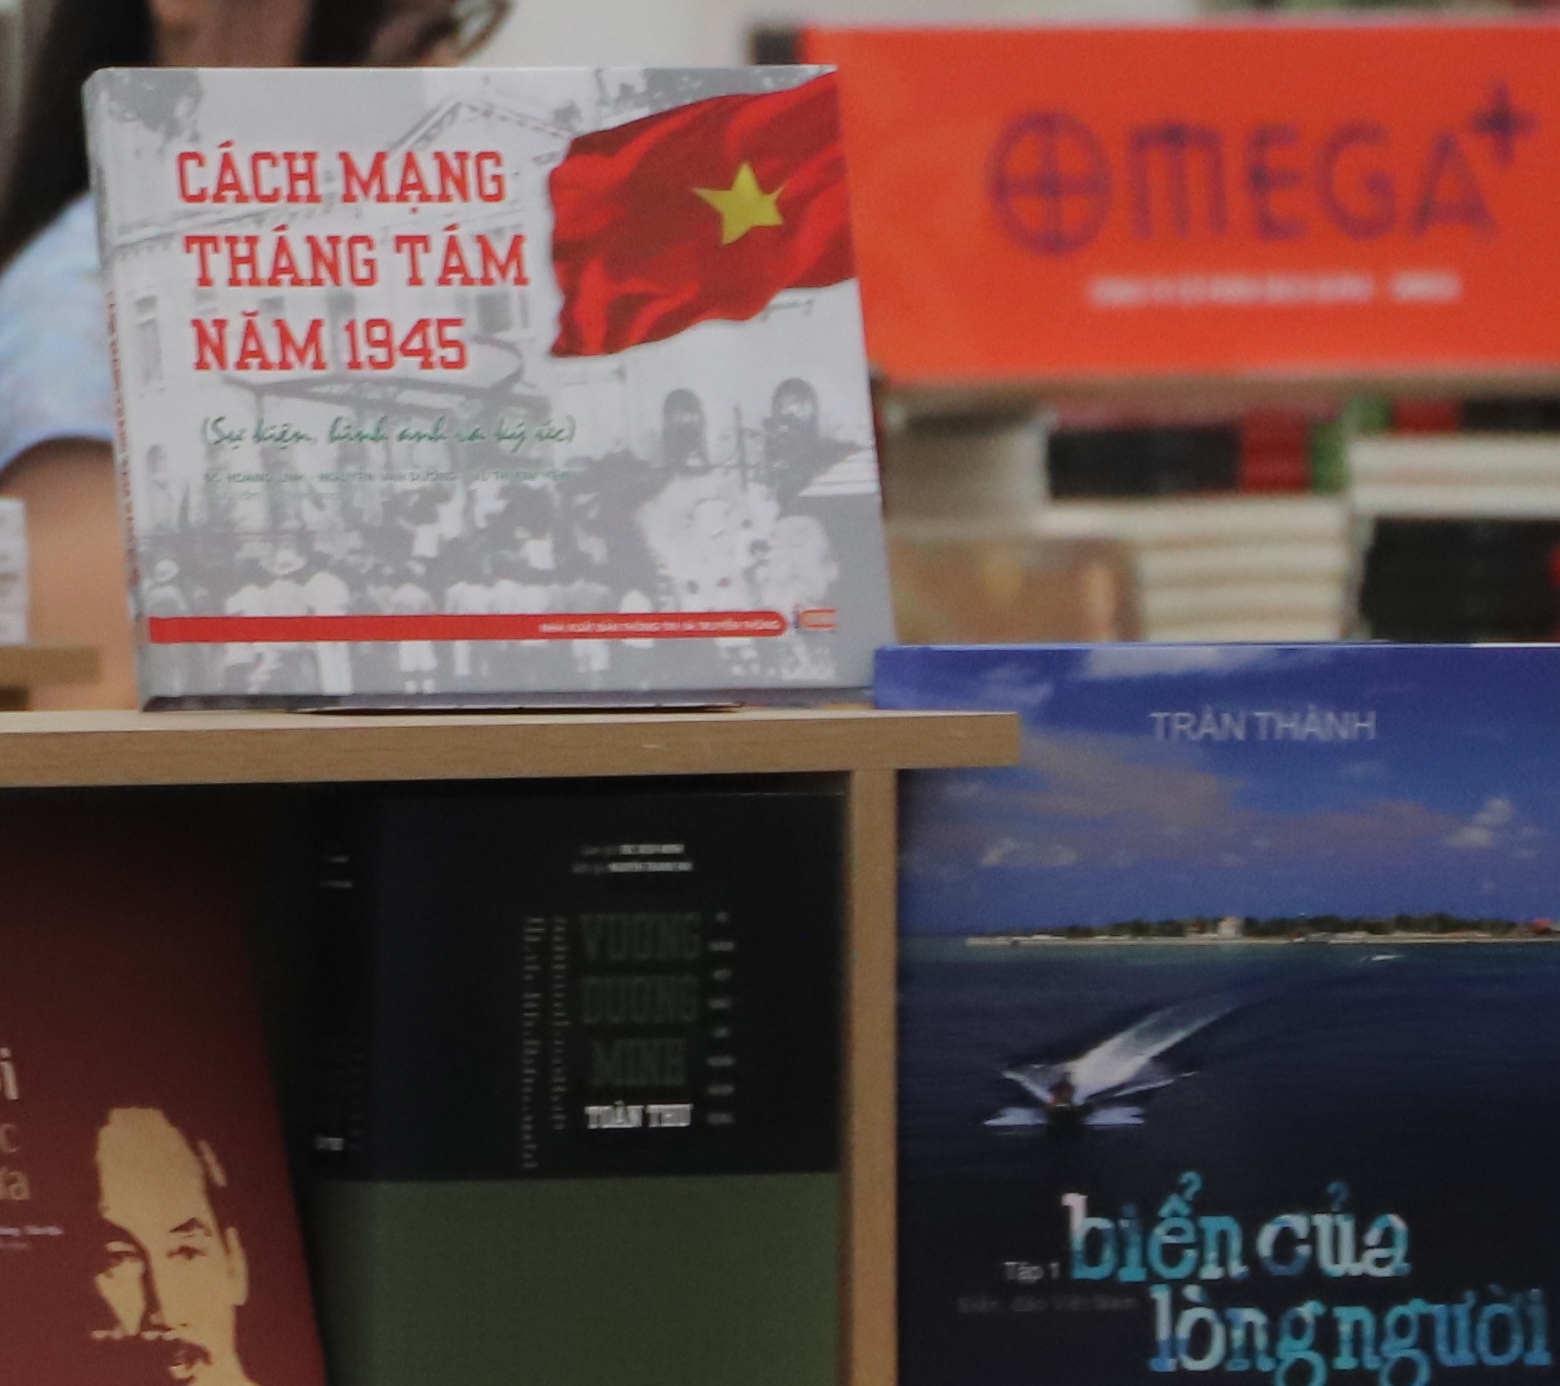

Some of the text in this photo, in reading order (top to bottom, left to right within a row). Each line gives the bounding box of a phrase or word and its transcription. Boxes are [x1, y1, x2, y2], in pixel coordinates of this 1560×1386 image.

[177, 141, 507, 216] CÁCH MẠNG
[184, 223, 530, 289] THÁNG TÁM
[191, 305, 468, 372] NĂM 1945
[1060, 1171, 1412, 1283] biển của
[1003, 1259, 1045, 1286] Tập
